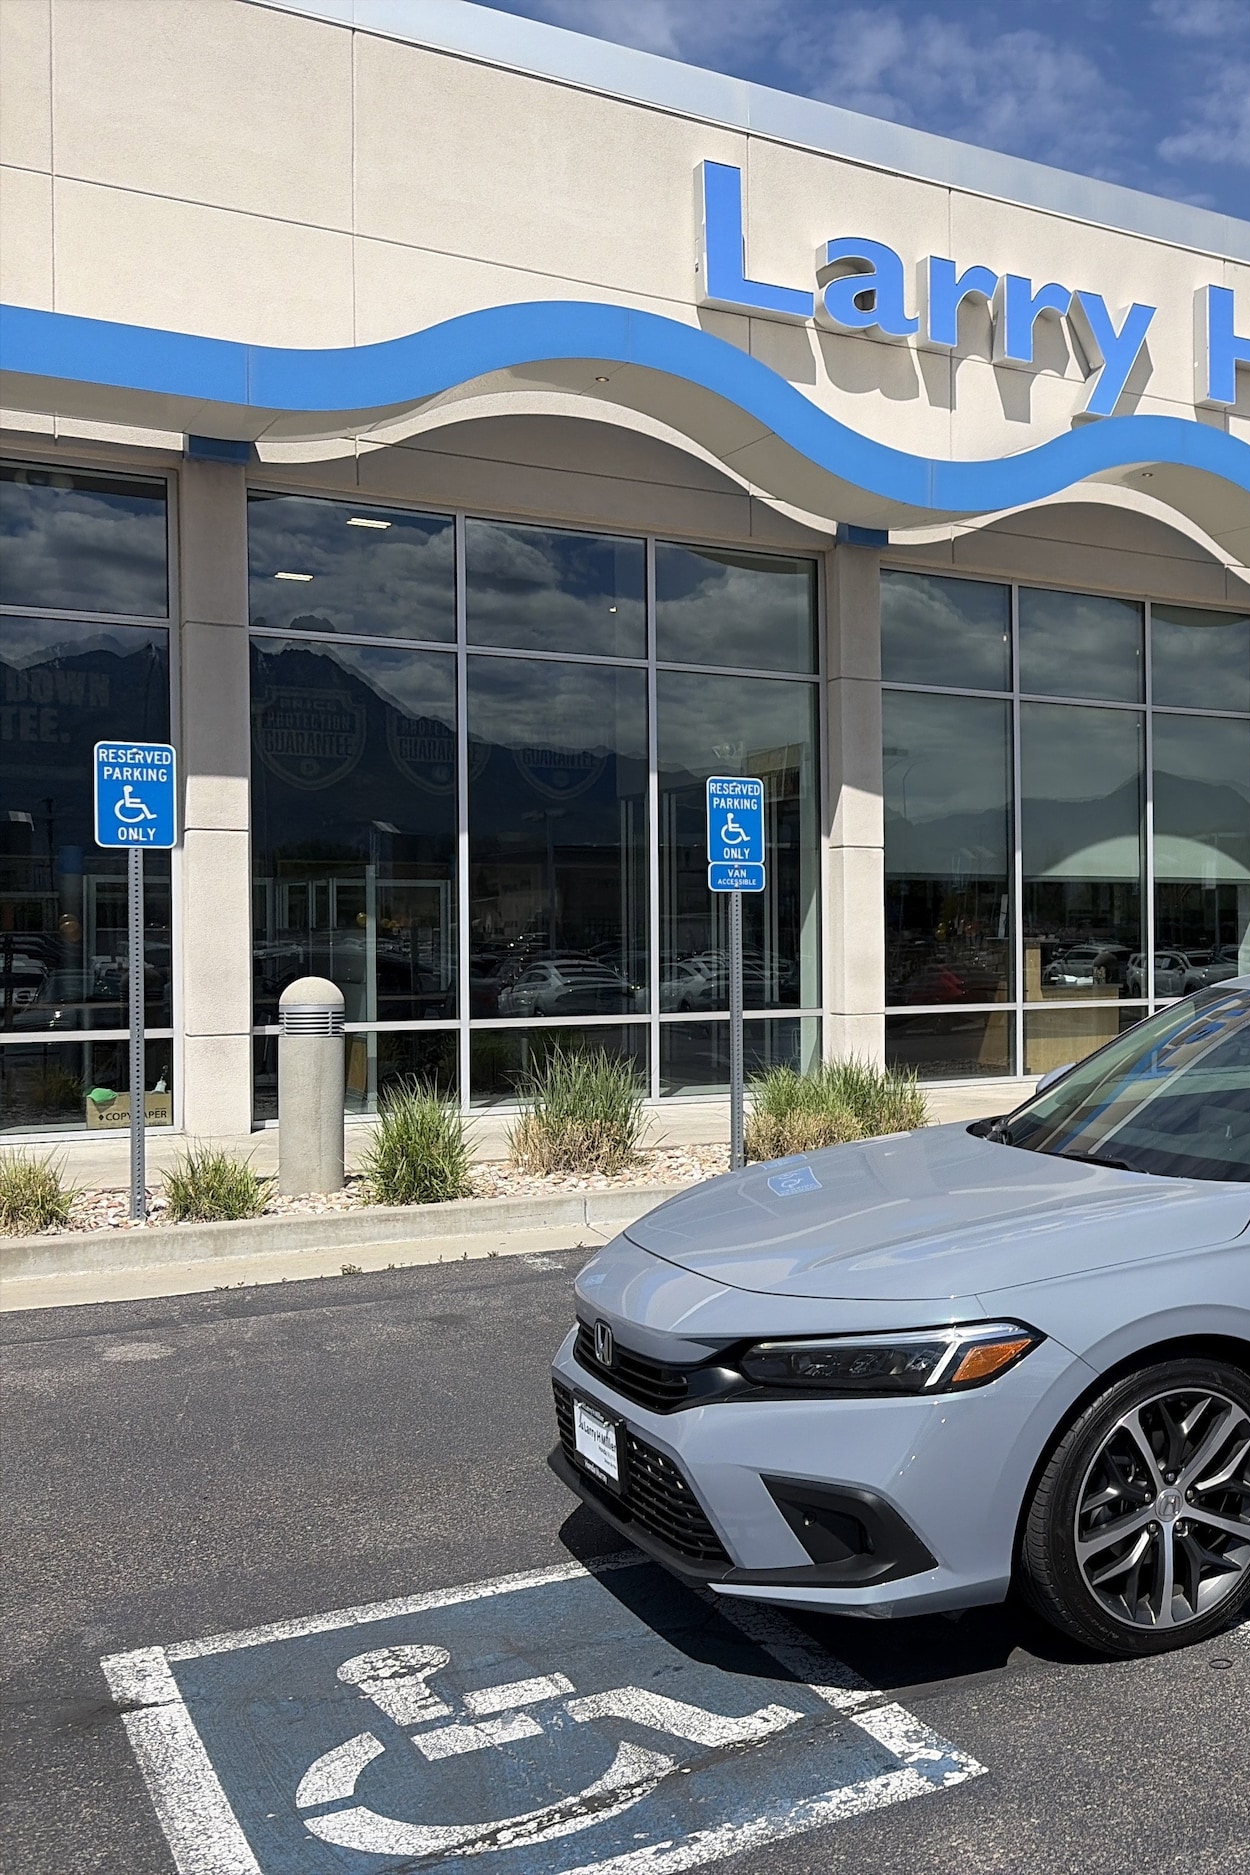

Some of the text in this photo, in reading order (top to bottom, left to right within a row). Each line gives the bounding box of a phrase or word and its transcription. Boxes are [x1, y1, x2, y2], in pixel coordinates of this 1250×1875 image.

[702, 160, 1156, 419] Larry
[264, 731, 353, 756] GUARANTEE
[99, 749, 171, 765] RESERVED
[103, 767, 167, 782] PARKING
[710, 782, 760, 796] RESERVED
[713, 798, 758, 810] PARKING
[117, 827, 157, 841] ONLY
[723, 848, 750, 859] ONLY
[728, 868, 747, 878] VAN
[717, 878, 757, 886] ACCESSIBLE
